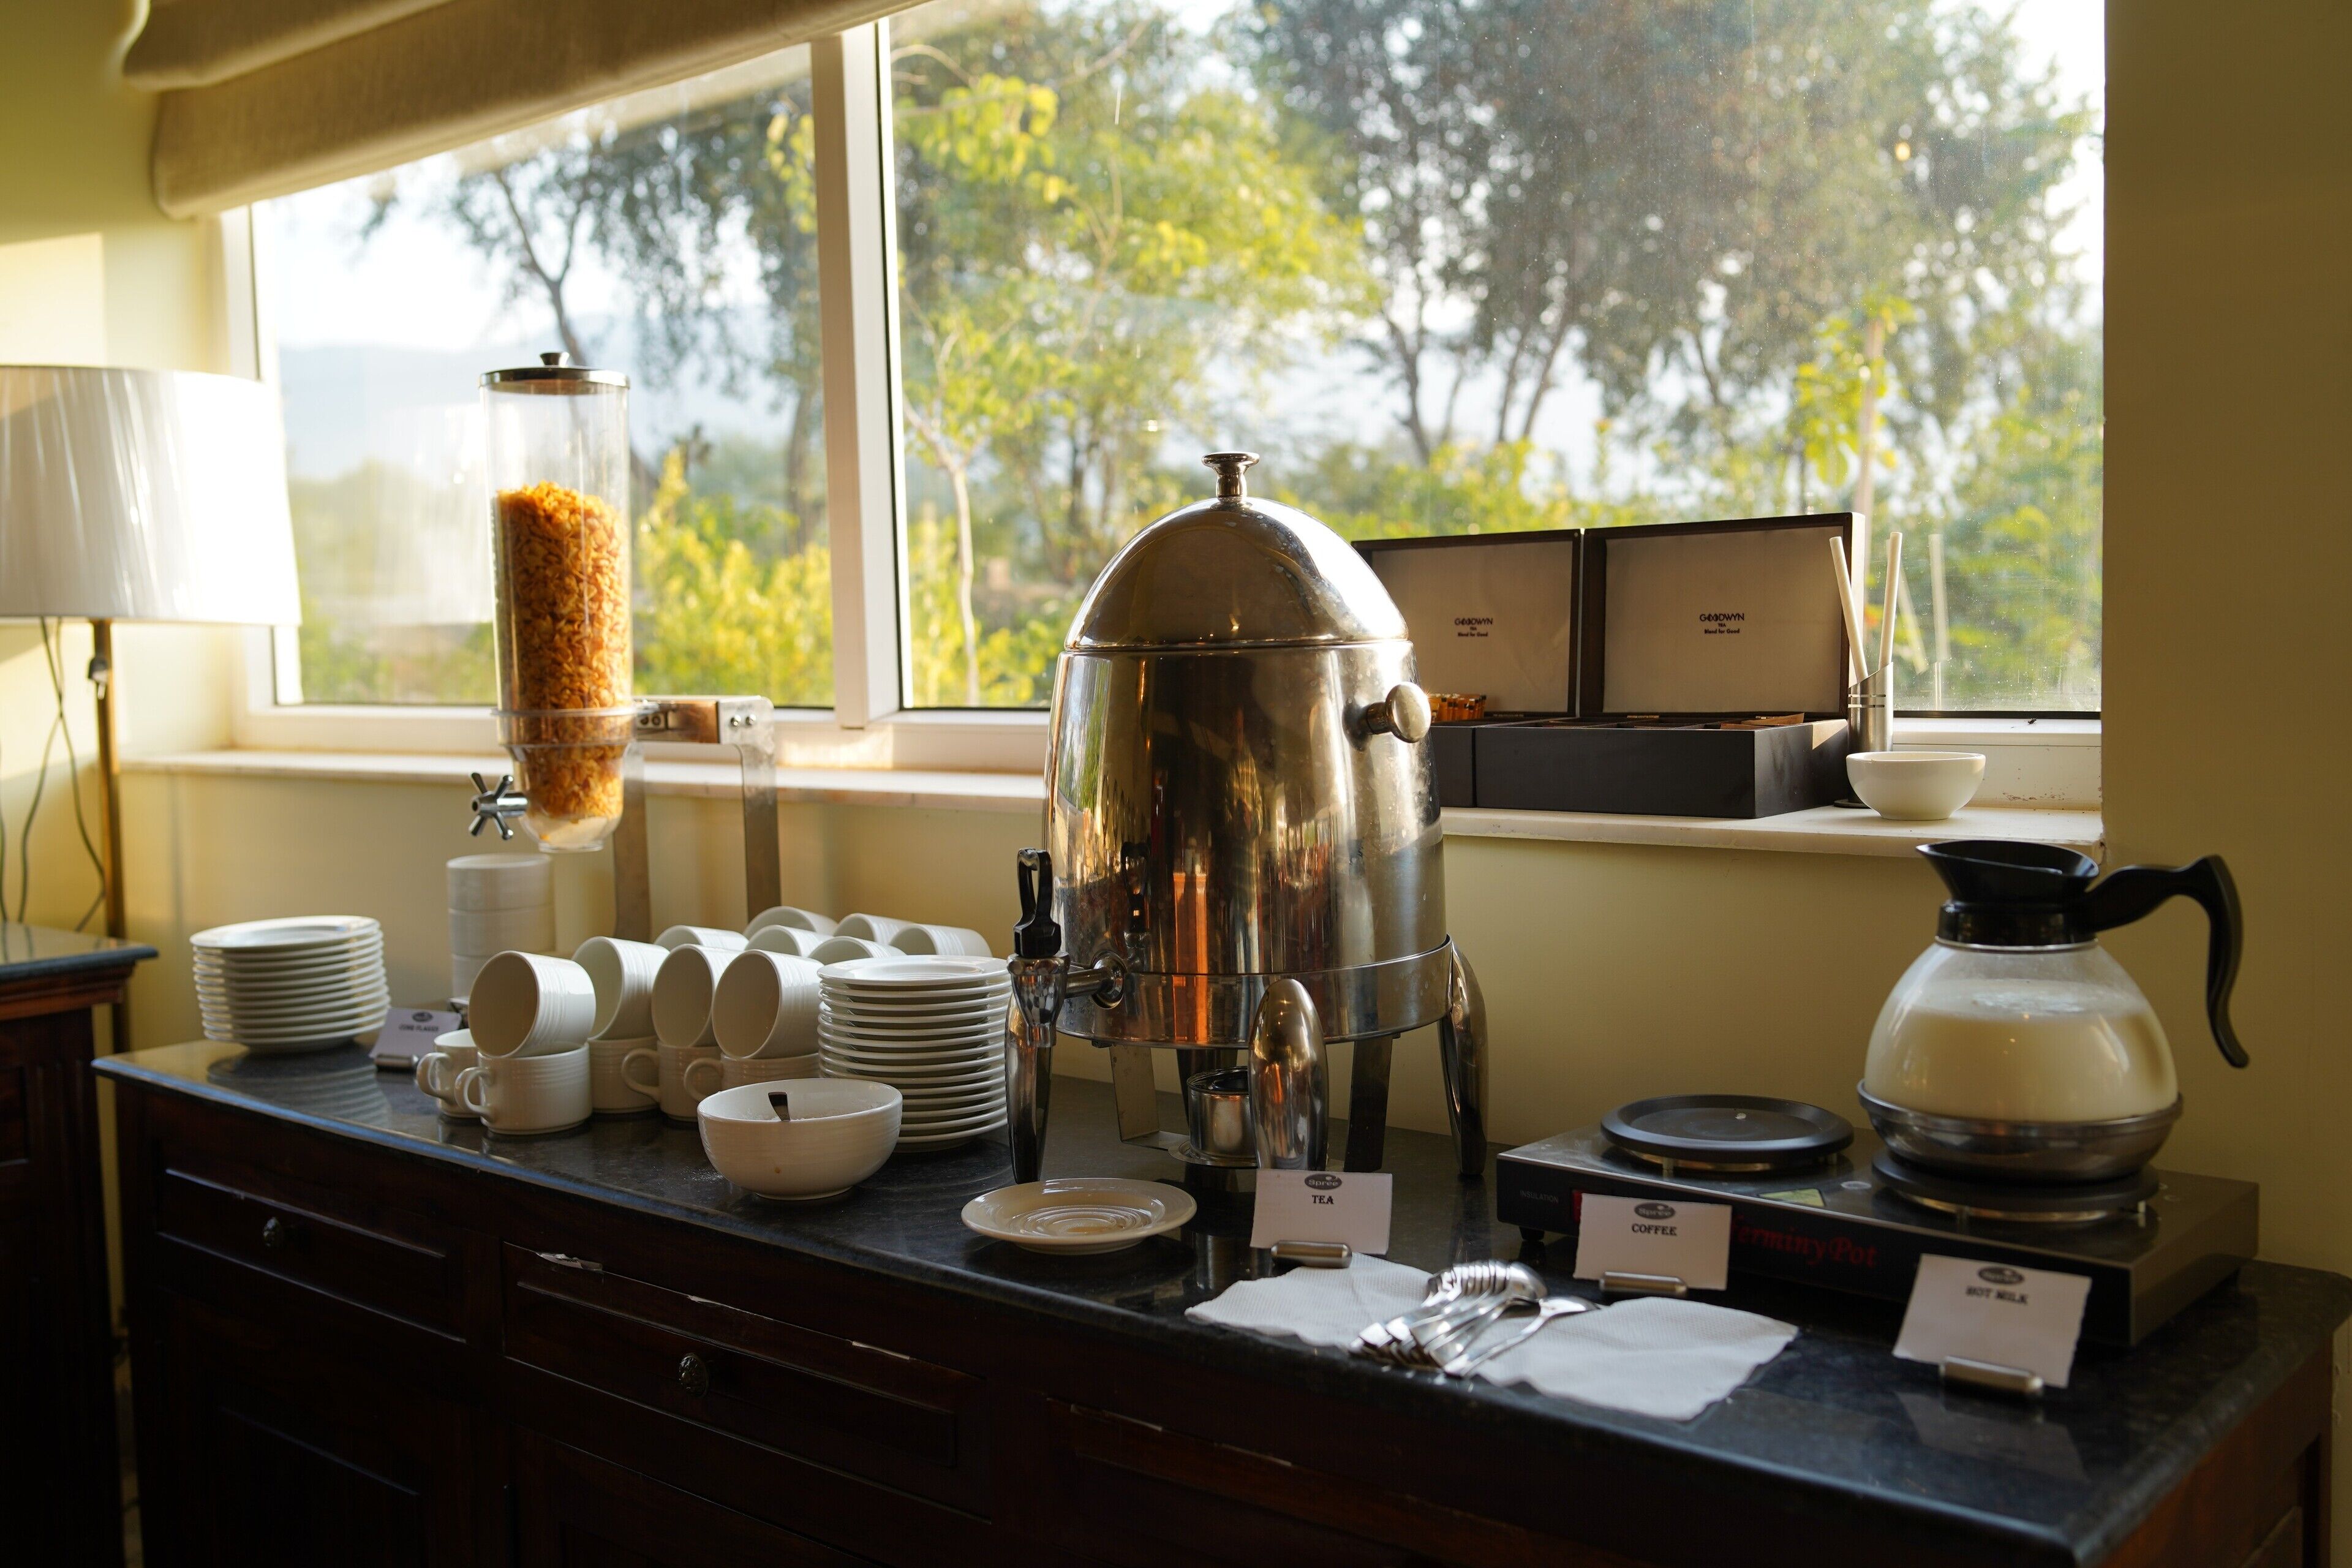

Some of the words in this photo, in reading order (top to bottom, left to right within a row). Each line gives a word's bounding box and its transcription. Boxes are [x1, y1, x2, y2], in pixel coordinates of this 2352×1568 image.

[1699, 613, 1744, 622] GOODWYN
[1312, 1195, 1334, 1205] TEA
[1520, 1190, 1559, 1203] INSULATION
[1632, 1223, 1678, 1236] COFFEE
[1966, 1286, 1993, 1298] HOT
[1996, 1289, 2029, 1305] MILK
